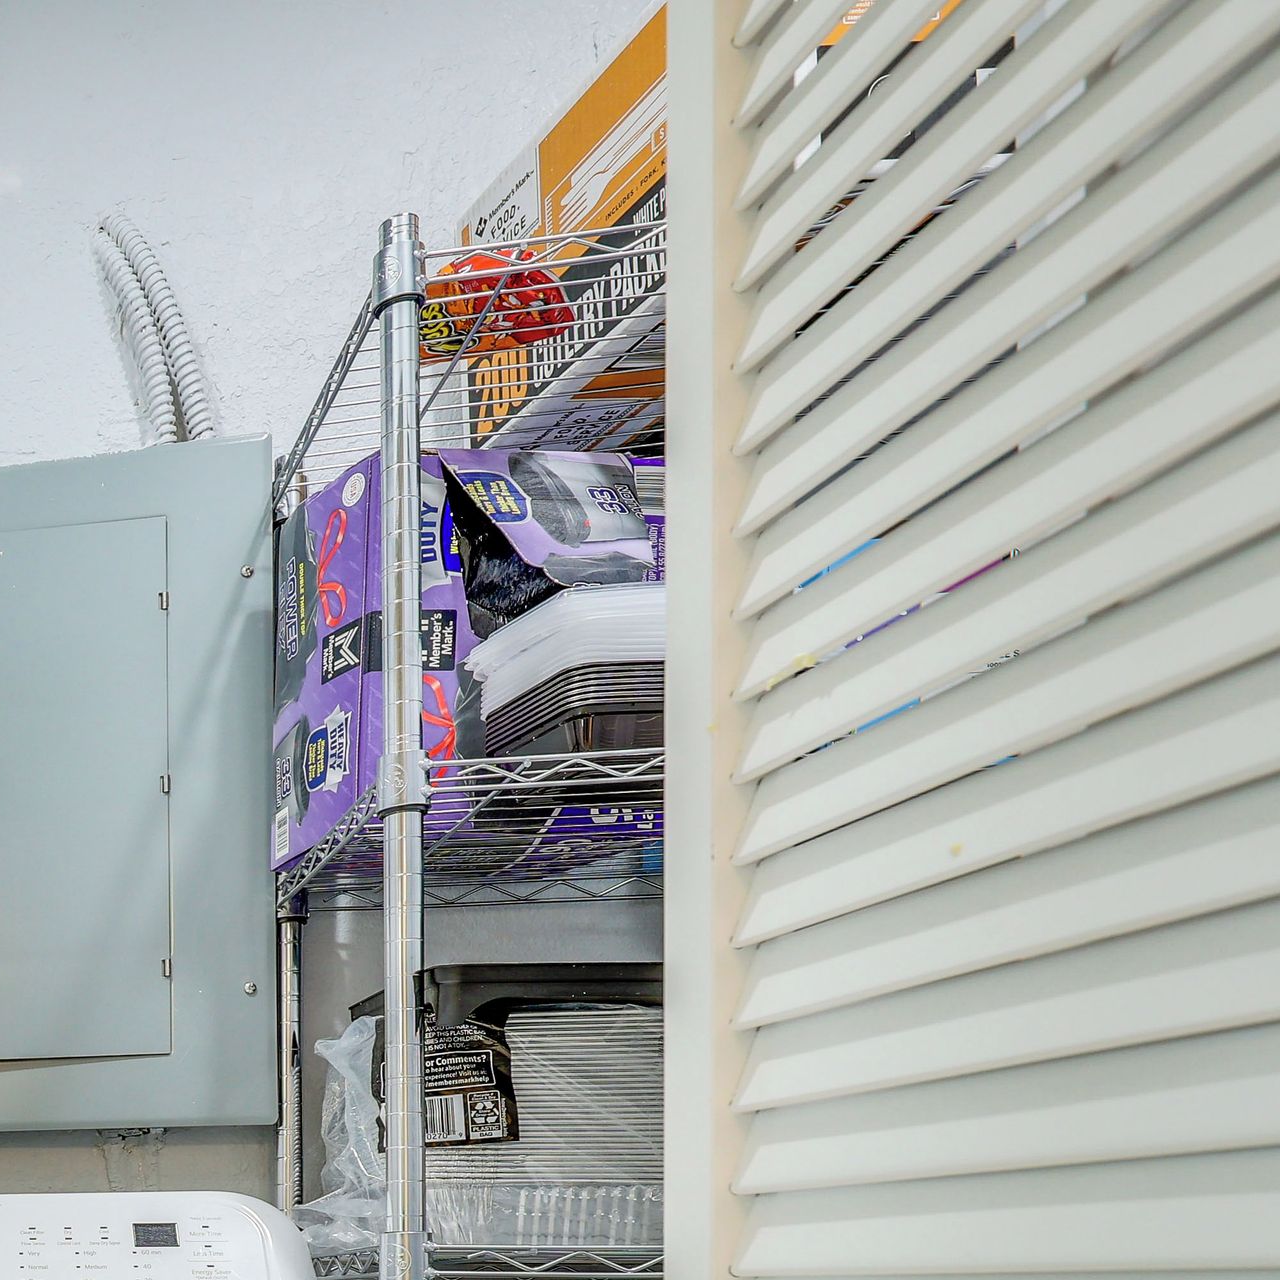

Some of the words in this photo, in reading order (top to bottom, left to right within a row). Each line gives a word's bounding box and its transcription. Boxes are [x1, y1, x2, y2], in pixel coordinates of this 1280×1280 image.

[605, 189, 634, 221] INCLUDES
[633, 193, 660, 236] WHITE
[476, 350, 528, 442] 200
[587, 485, 629, 515] 33
[421, 501, 438, 563] DUTY
[286, 556, 299, 662] POWER
[327, 634, 335, 679] Member's
[428, 613, 443, 668] Member's
[442, 625, 452, 655] Mark
[329, 729, 337, 771] DUTY
[336, 722, 344, 770] HEAVY
[281, 757, 292, 798] 33
[435, 1055, 486, 1066] Comments?
